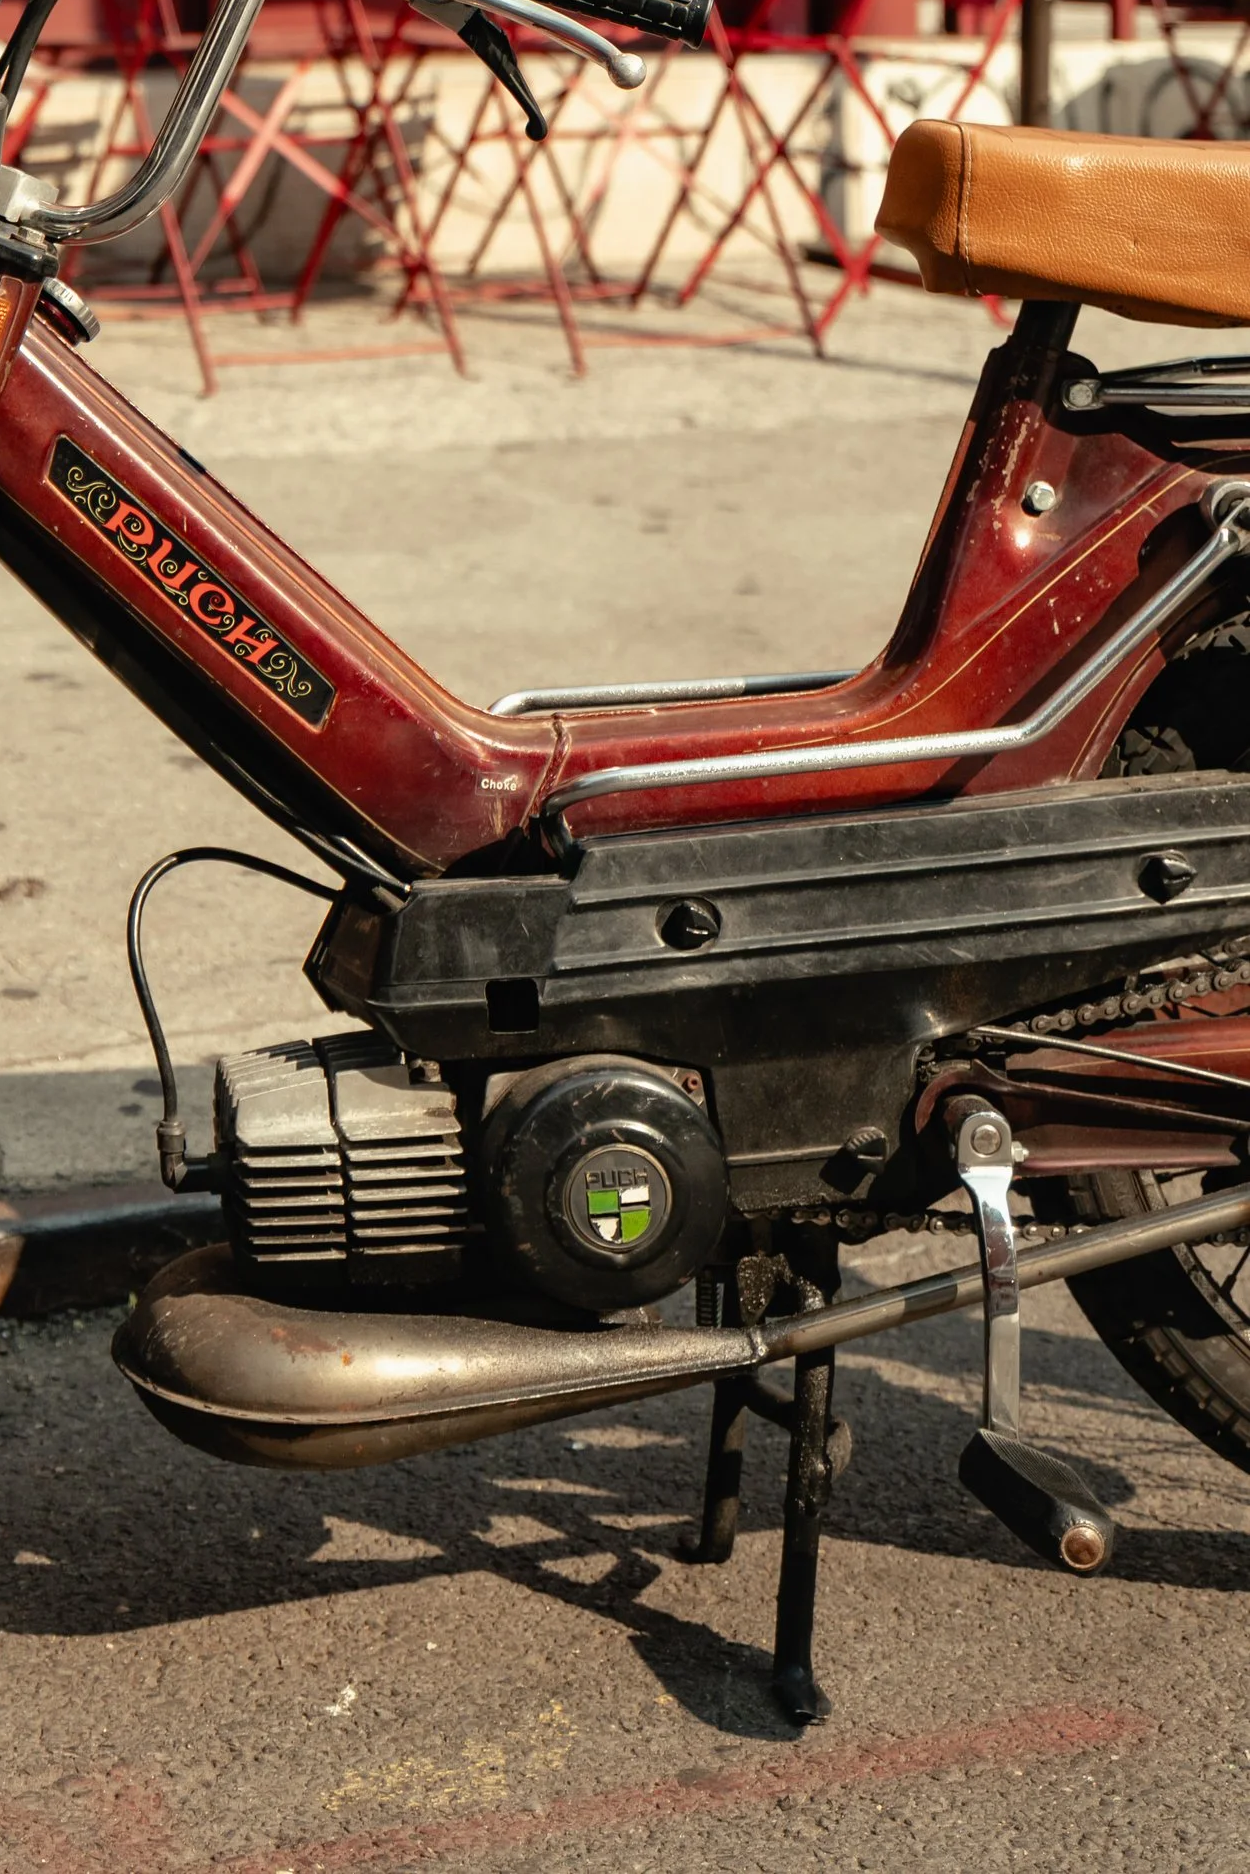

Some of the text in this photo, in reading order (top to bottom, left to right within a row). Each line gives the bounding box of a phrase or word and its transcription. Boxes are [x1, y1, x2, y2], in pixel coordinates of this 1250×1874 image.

[103, 500, 280, 666] PUCH
[480, 777, 517, 791] Choke
[584, 1167, 649, 1190] PUCH
